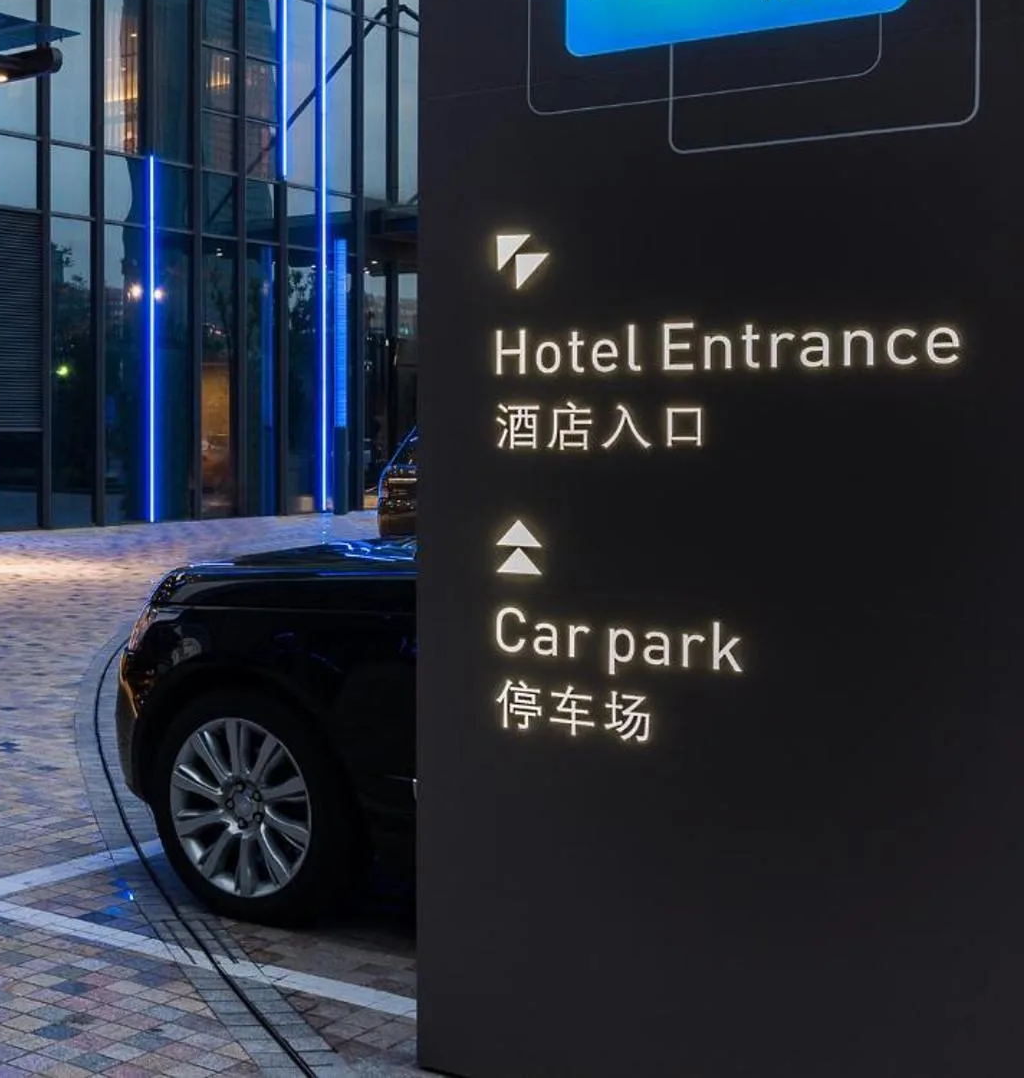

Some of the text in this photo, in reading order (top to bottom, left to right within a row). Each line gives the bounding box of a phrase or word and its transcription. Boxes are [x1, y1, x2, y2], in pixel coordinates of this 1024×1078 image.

[495, 321, 961, 376] Hotel Entrance
[495, 401, 704, 451] 酒店入口
[495, 606, 744, 676] Car park
[495, 679, 652, 743] 停车场
